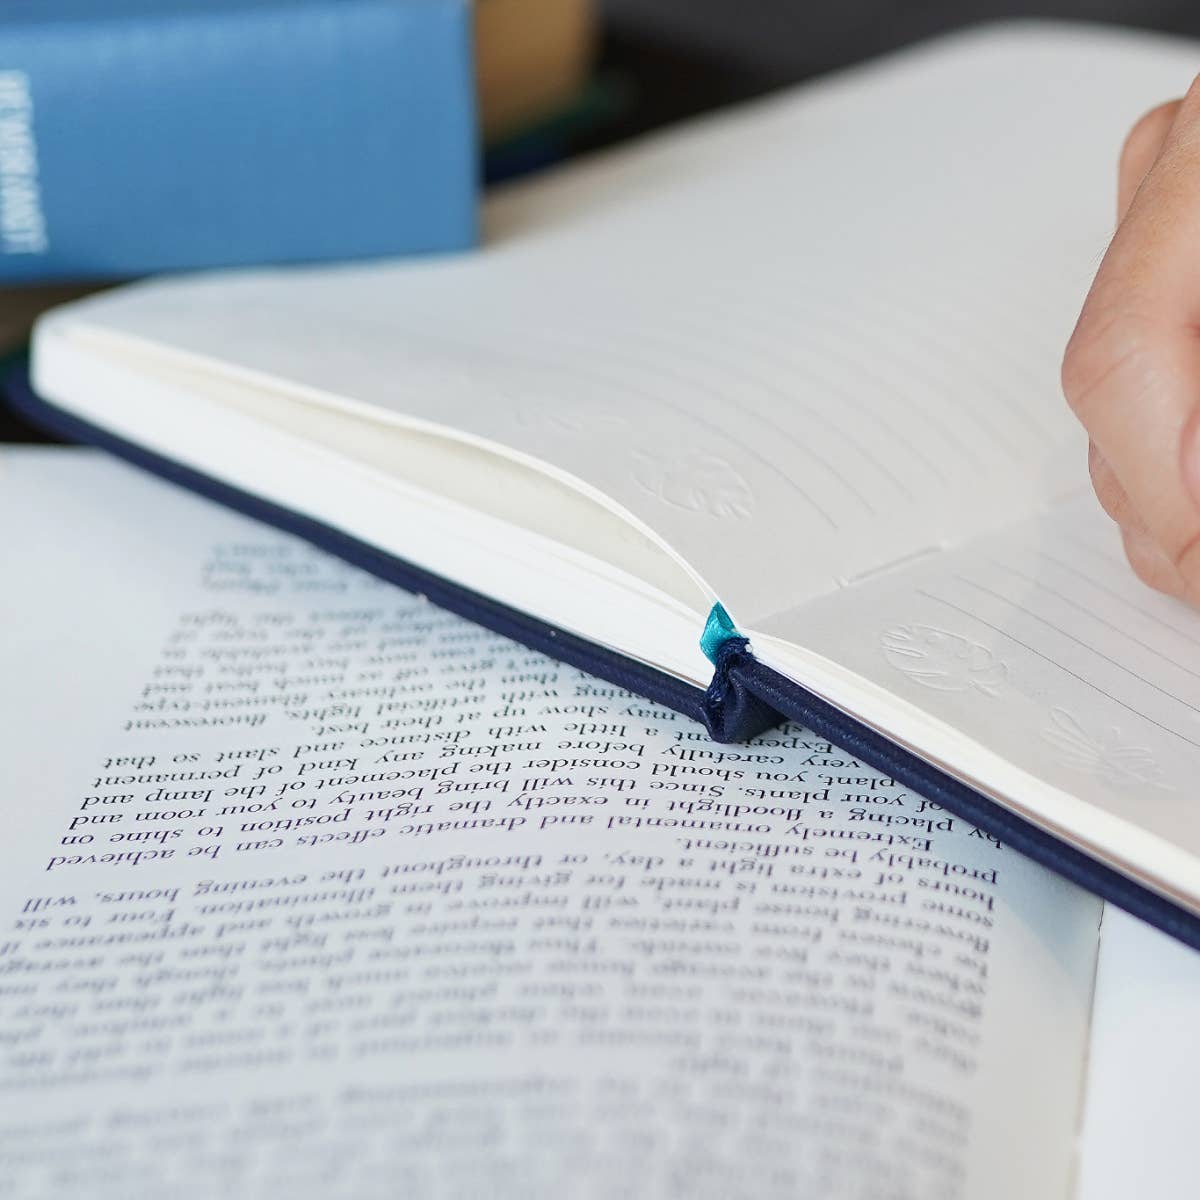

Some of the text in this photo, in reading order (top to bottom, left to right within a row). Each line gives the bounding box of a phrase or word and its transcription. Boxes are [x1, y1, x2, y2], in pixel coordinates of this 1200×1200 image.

[457, 711, 482, 724] at
[492, 704, 526, 718] up
[539, 705, 609, 718] show
[618, 707, 676, 721] may
[380, 715, 443, 731] their
[563, 723, 627, 738] little
[643, 727, 659, 736] a
[359, 729, 471, 748] distance
[488, 724, 547, 740] with
[292, 741, 345, 759] and
[672, 729, 834, 755] Experient
[103, 755, 156, 770] that
[172, 752, 201, 764] so
[215, 747, 281, 764] slant
[92, 740, 861, 789] very carefully before making any kind of permanent
[79, 758, 897, 811] plant, you should consider the placement of the lamp and
[68, 777, 945, 831] of your plants. Since this will bring beauty to your room and
[61, 792, 1003, 851] by placing a floodlight in exactly the right position to shine on
[45, 815, 935, 872] Extremely ornamental and dramatic effects can be achieved
[676, 838, 999, 886] probably be sufficient.
[21, 852, 994, 914] hours of extra light a day, or throughout the evening hours, will
[389, 879, 464, 897] them
[477, 869, 574, 890] giving
[585, 874, 627, 891] for
[640, 876, 722, 893] made
[735, 881, 757, 895] is
[770, 882, 908, 908] provision
[62, 915, 92, 929] to
[105, 907, 177, 925] Four
[921, 901, 994, 928] some
[13, 917, 53, 932] six
